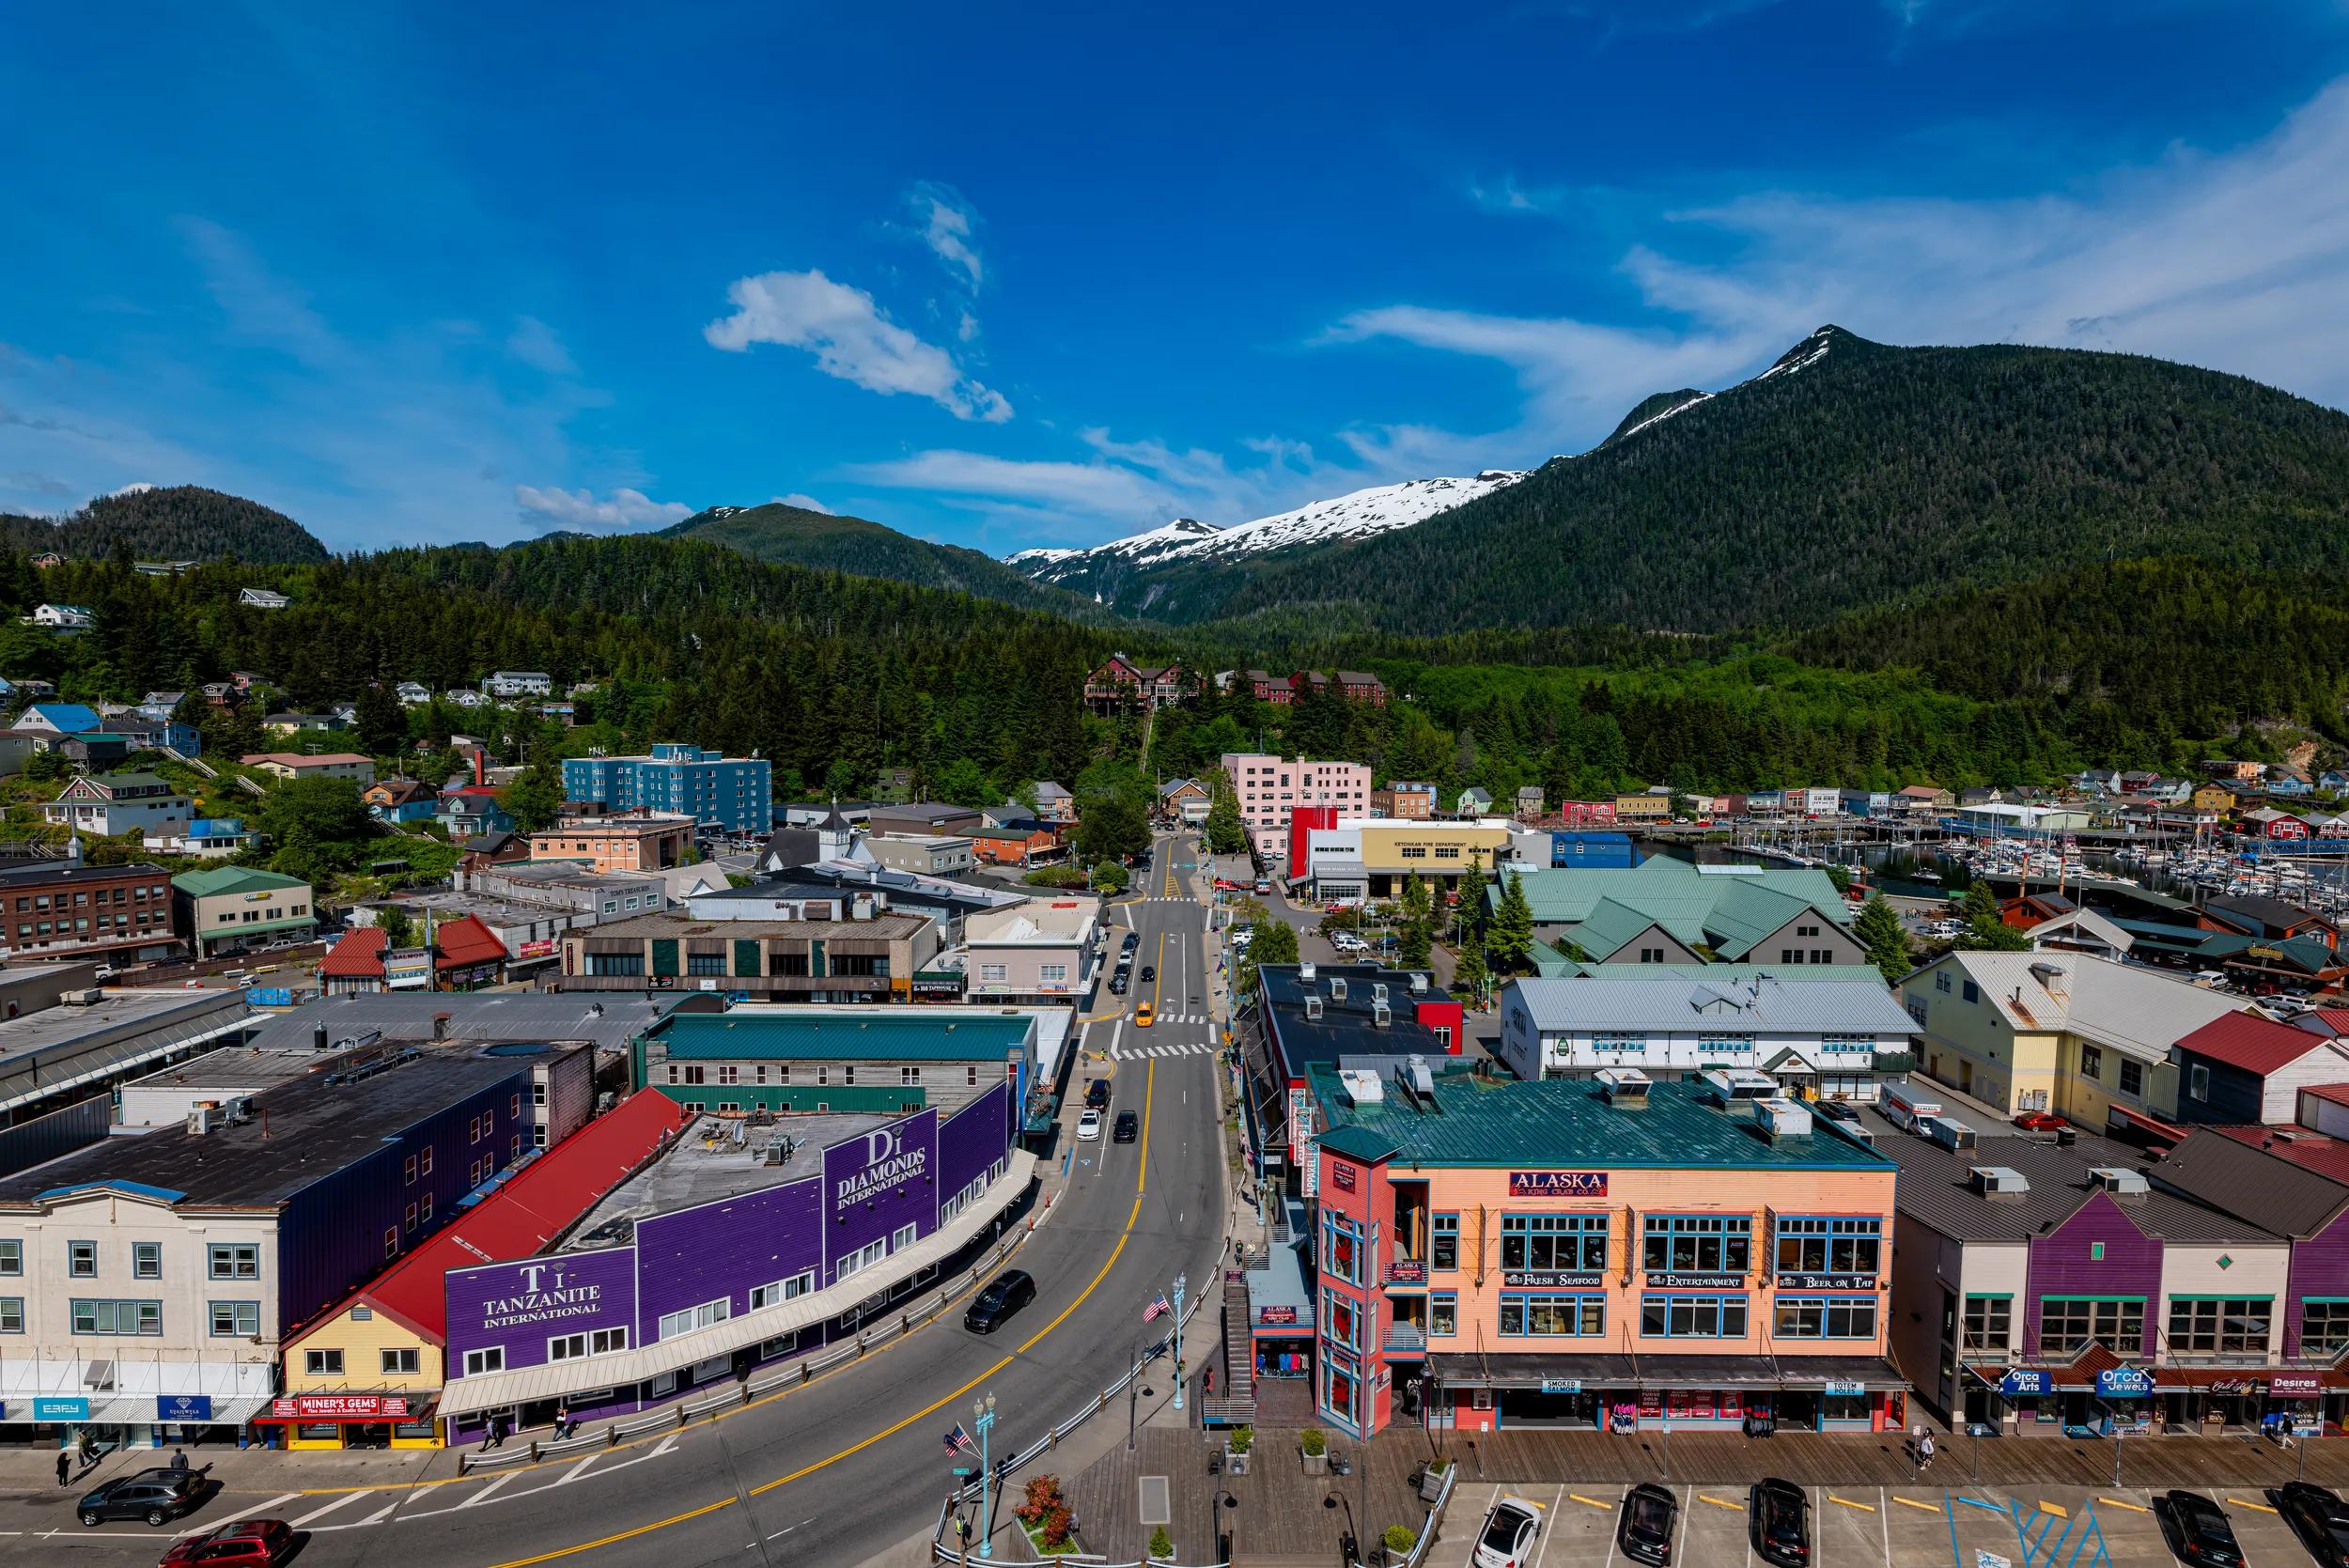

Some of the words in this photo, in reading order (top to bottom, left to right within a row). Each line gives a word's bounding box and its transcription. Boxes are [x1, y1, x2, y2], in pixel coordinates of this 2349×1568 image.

[837, 1146, 926, 1200] DIAMONDS
[837, 1164, 926, 1211] INTERNATIONAL
[1516, 1173, 1602, 1189] ALASKA
[483, 1284, 600, 1316] TANZANITE
[483, 1303, 600, 1329] INTERNATIONAL
[2012, 1372, 2040, 1382] Orca
[2102, 1370, 2143, 1382] Orca
[2274, 1378, 2317, 1388] Desires
[2018, 1381, 2040, 1391] Arts
[302, 1399, 345, 1409] MINER'S
[347, 1398, 377, 1408] GEMS
